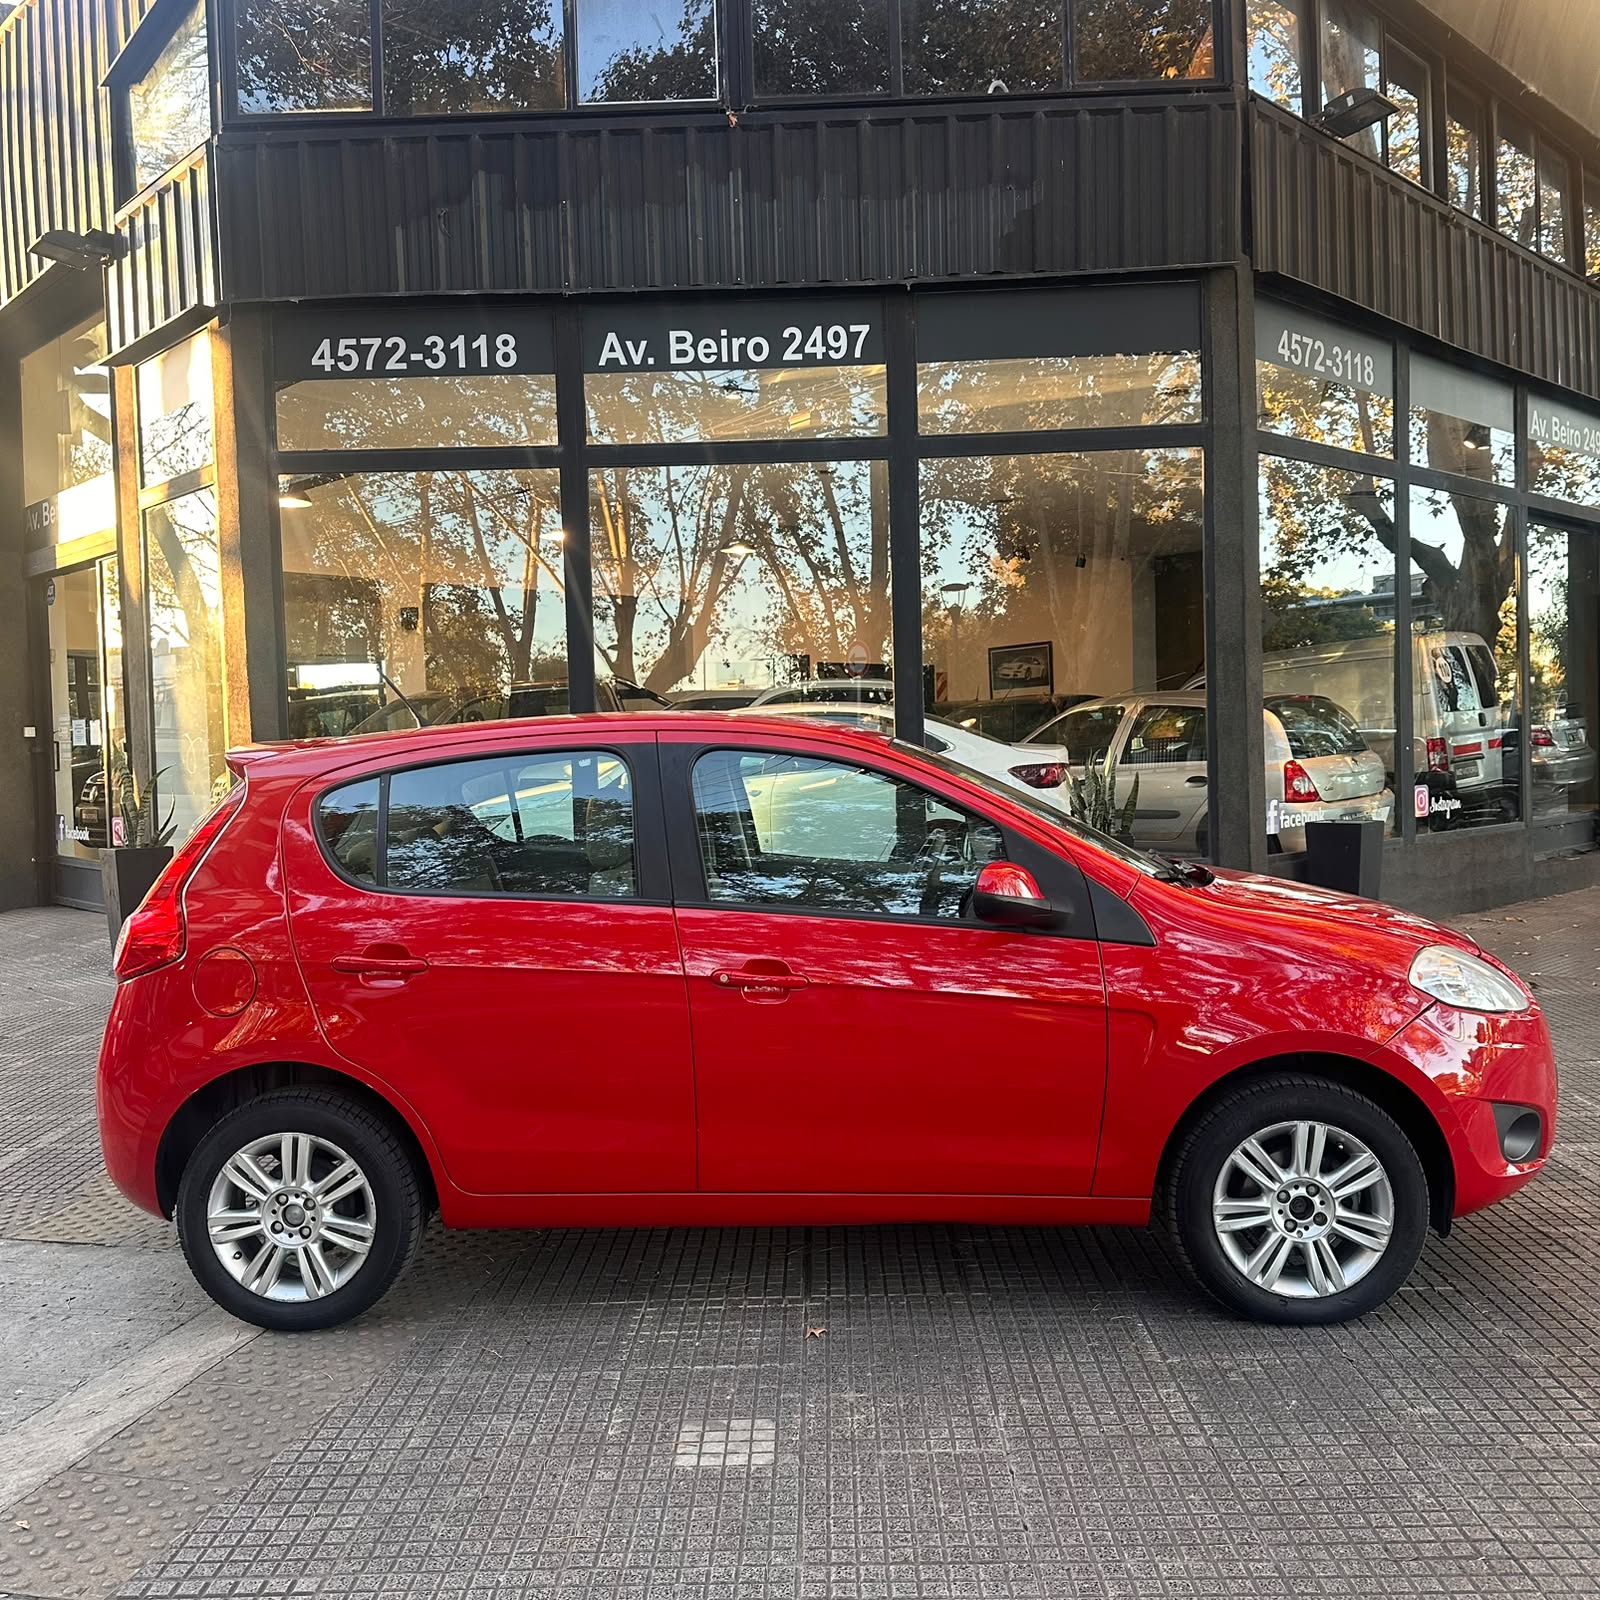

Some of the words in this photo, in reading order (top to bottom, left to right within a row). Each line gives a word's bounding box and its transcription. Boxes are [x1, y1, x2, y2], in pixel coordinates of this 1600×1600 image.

[311, 333, 518, 372] 4572-3118
[598, 331, 655, 367] Av.
[668, 328, 770, 365] Beiro
[782, 324, 871, 362] 2497
[1277, 329, 1375, 387] 4572-3118
[1530, 409, 1549, 439] Av.
[1551, 415, 1581, 448] Beiro
